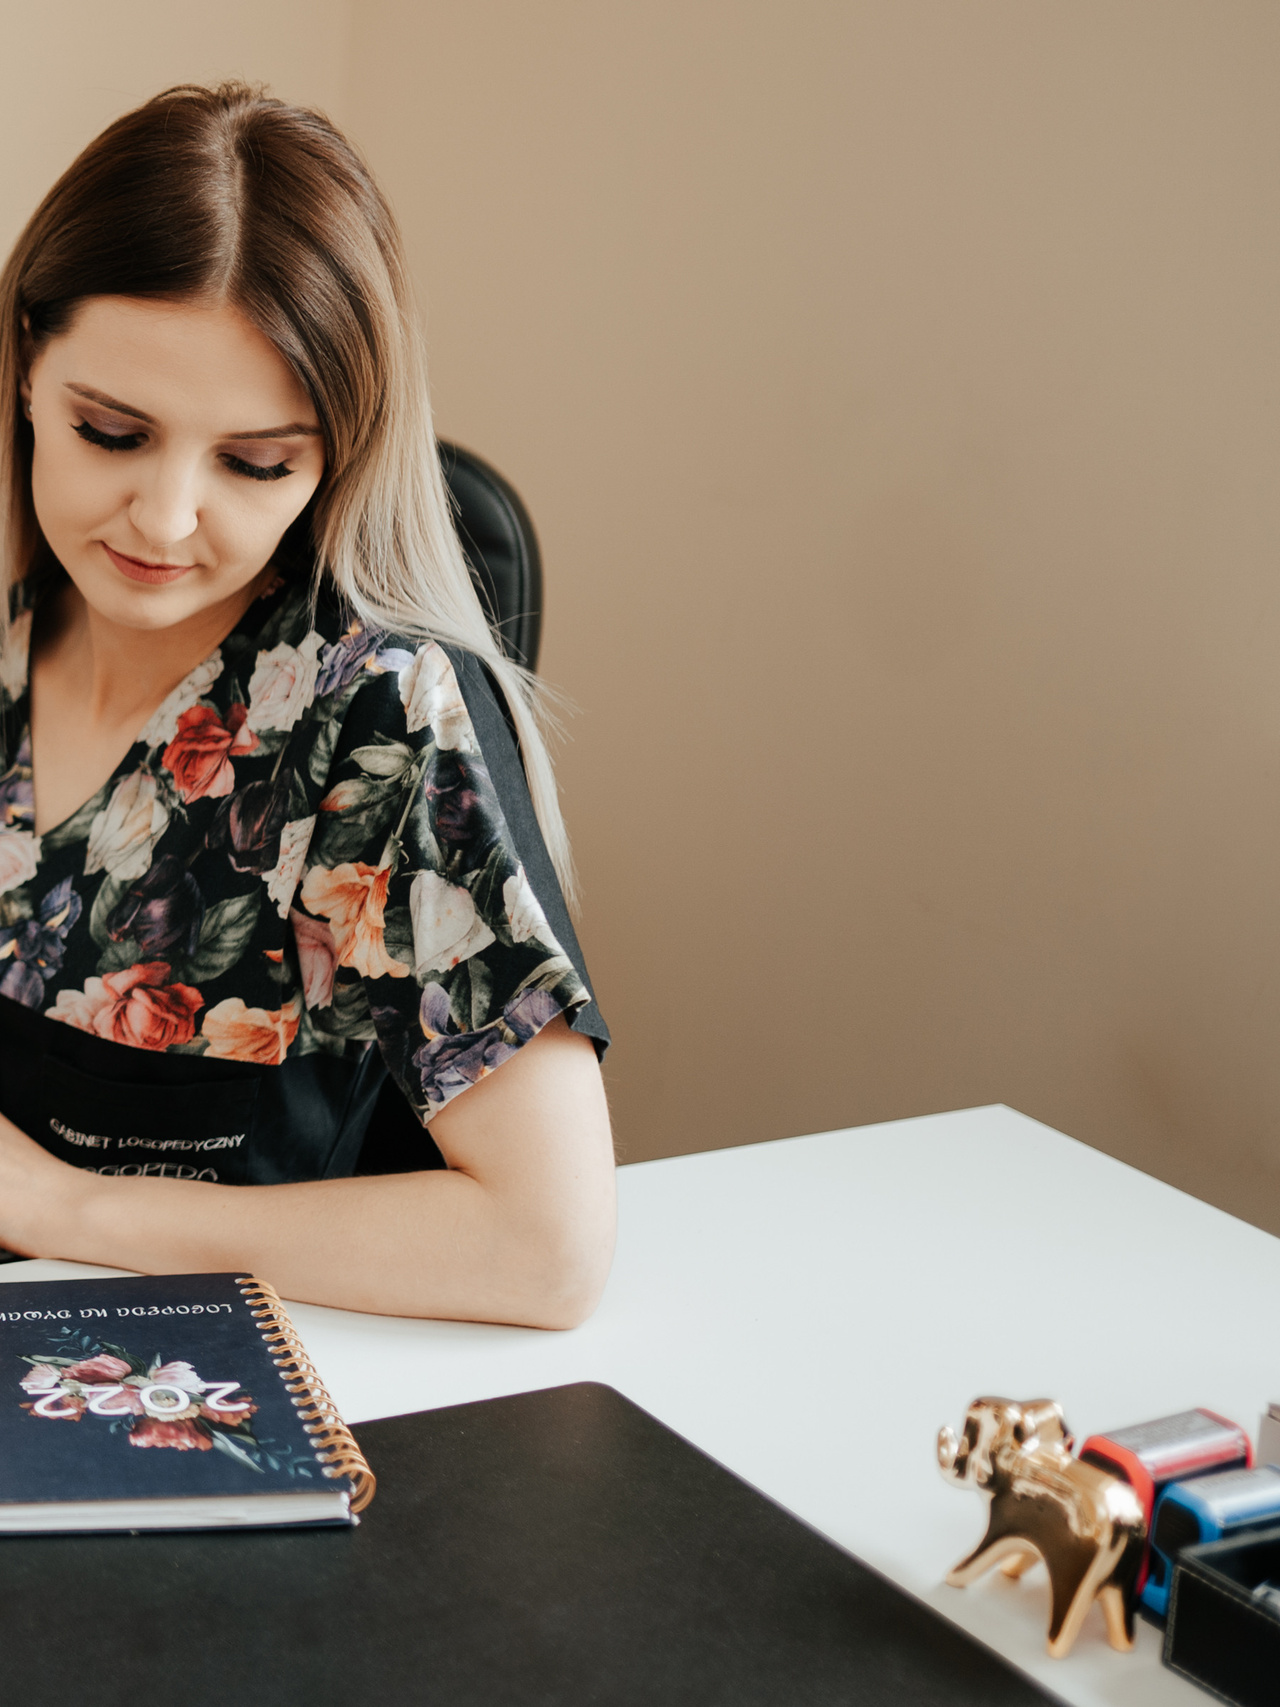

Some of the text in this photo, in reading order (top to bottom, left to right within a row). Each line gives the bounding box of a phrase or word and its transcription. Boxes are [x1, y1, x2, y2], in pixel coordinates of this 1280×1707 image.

[49, 1117, 246, 1153] GABINET LOGOPEDYCZNY
[117, 1303, 233, 1318] LOGOPEDA
[27, 1381, 251, 1417] 2022
